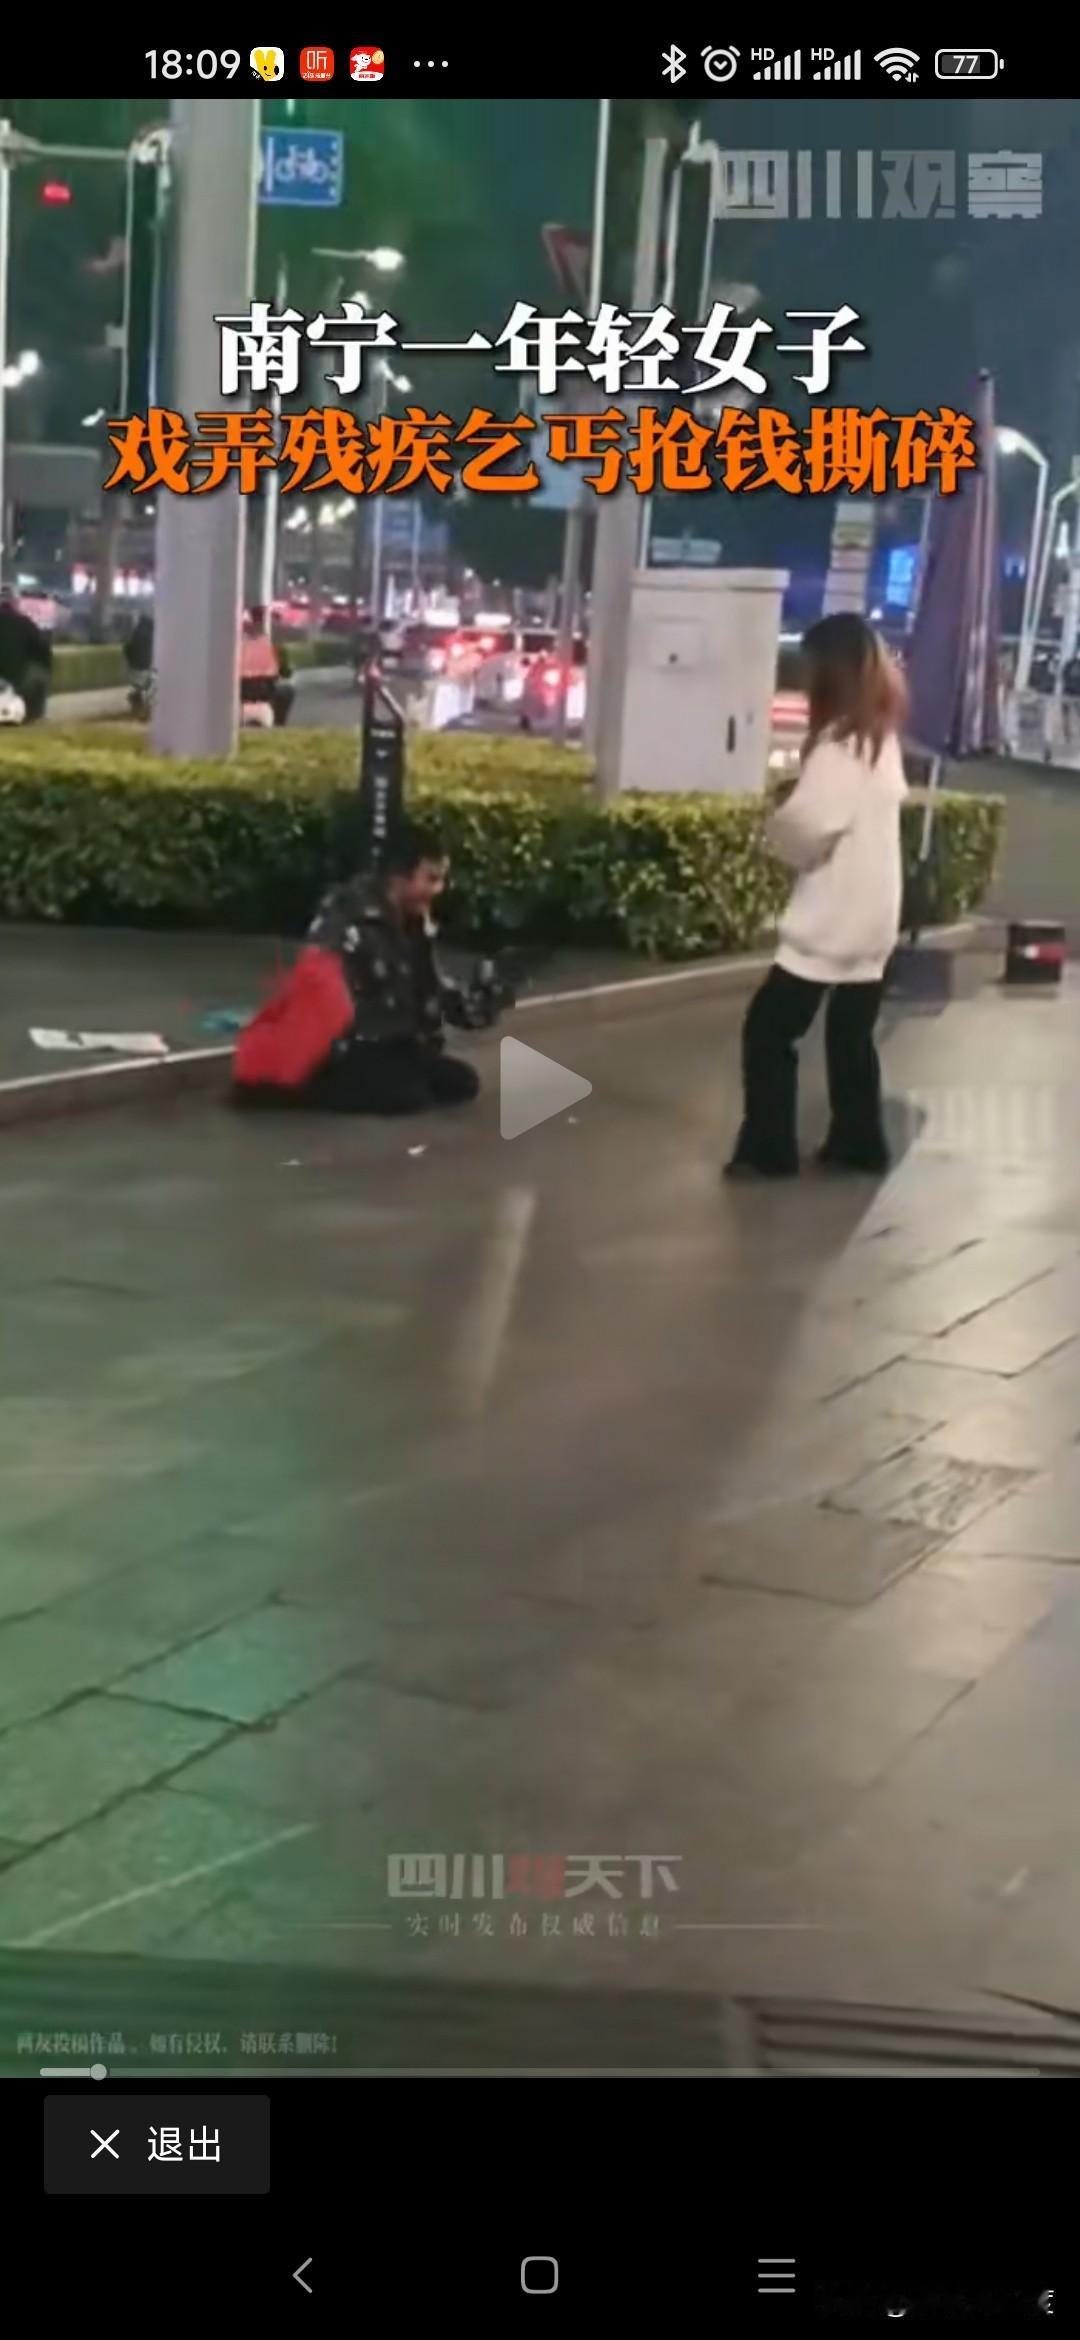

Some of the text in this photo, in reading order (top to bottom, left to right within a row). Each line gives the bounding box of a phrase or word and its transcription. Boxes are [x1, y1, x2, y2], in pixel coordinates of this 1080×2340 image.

[306, 50, 328, 70] 听
[750, 47, 775, 61] HD
[810, 47, 835, 61] HD
[145, 49, 241, 80] 18:09
[952, 55, 979, 74] 77
[147, 2124, 222, 2163] 退出
